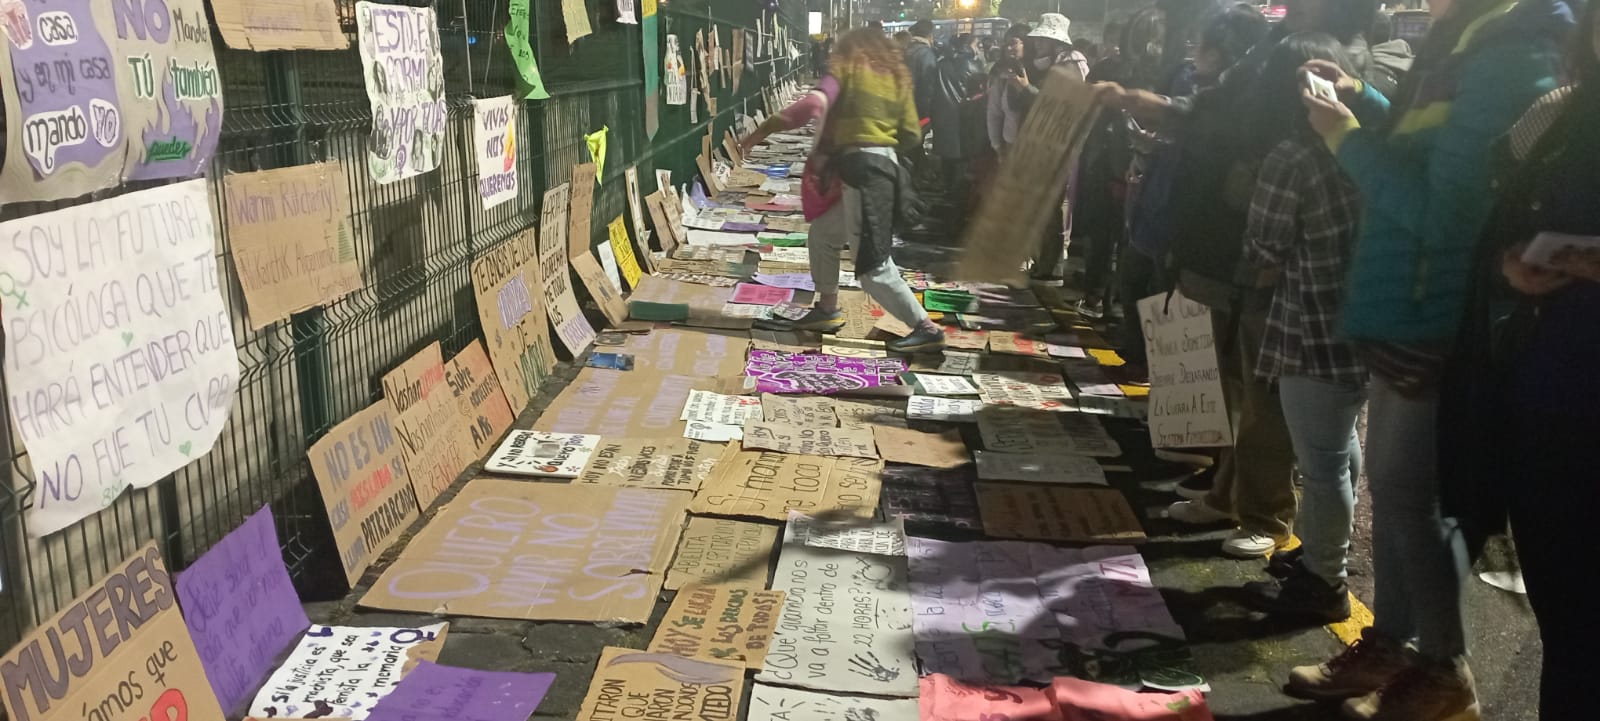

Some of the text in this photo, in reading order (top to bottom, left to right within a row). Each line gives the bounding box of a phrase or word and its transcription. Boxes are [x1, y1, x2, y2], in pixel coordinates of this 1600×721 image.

[113, 0, 170, 44] NO
[54, 52, 76, 95] mi
[79, 56, 110, 80] casa
[127, 53, 155, 98] TÚ
[171, 59, 218, 98] también
[26, 104, 117, 169] mando YO
[483, 104, 509, 131] VIVAS
[486, 134, 505, 159] NOS
[480, 171, 515, 200] QUEREMOS
[13, 195, 201, 288] SOY LA FUTURA
[474, 258, 489, 295] TE
[10, 279, 131, 371] PSICÓLOGA
[136, 262, 192, 318] QUE
[194, 249, 219, 291] TE
[13, 310, 231, 441] HARÁ ENTENDER QUE
[40, 454, 84, 509] NO
[92, 426, 136, 486] FUE
[136, 401, 172, 457] TU
[324, 441, 350, 492] NO
[348, 425, 372, 471] ES
[370, 411, 395, 456] UN
[582, 470, 604, 484] HOY
[779, 463, 822, 493] toca
[360, 483, 417, 554] PATRIARCADO
[707, 493, 768, 510] Si
[388, 496, 542, 600] QUIERO
[489, 512, 600, 607] VIVIR NO
[792, 559, 809, 584] nos
[1, 547, 174, 721] MUJERES
[803, 563, 839, 679] va a faltar dentro de
[854, 633, 874, 648] 22
[146, 640, 178, 688] que
[312, 646, 327, 656] es
[330, 649, 351, 664] que
[347, 662, 372, 672] la
[373, 643, 406, 689] memoria
[621, 692, 650, 718] QUE
[644, 688, 675, 721] ARON
